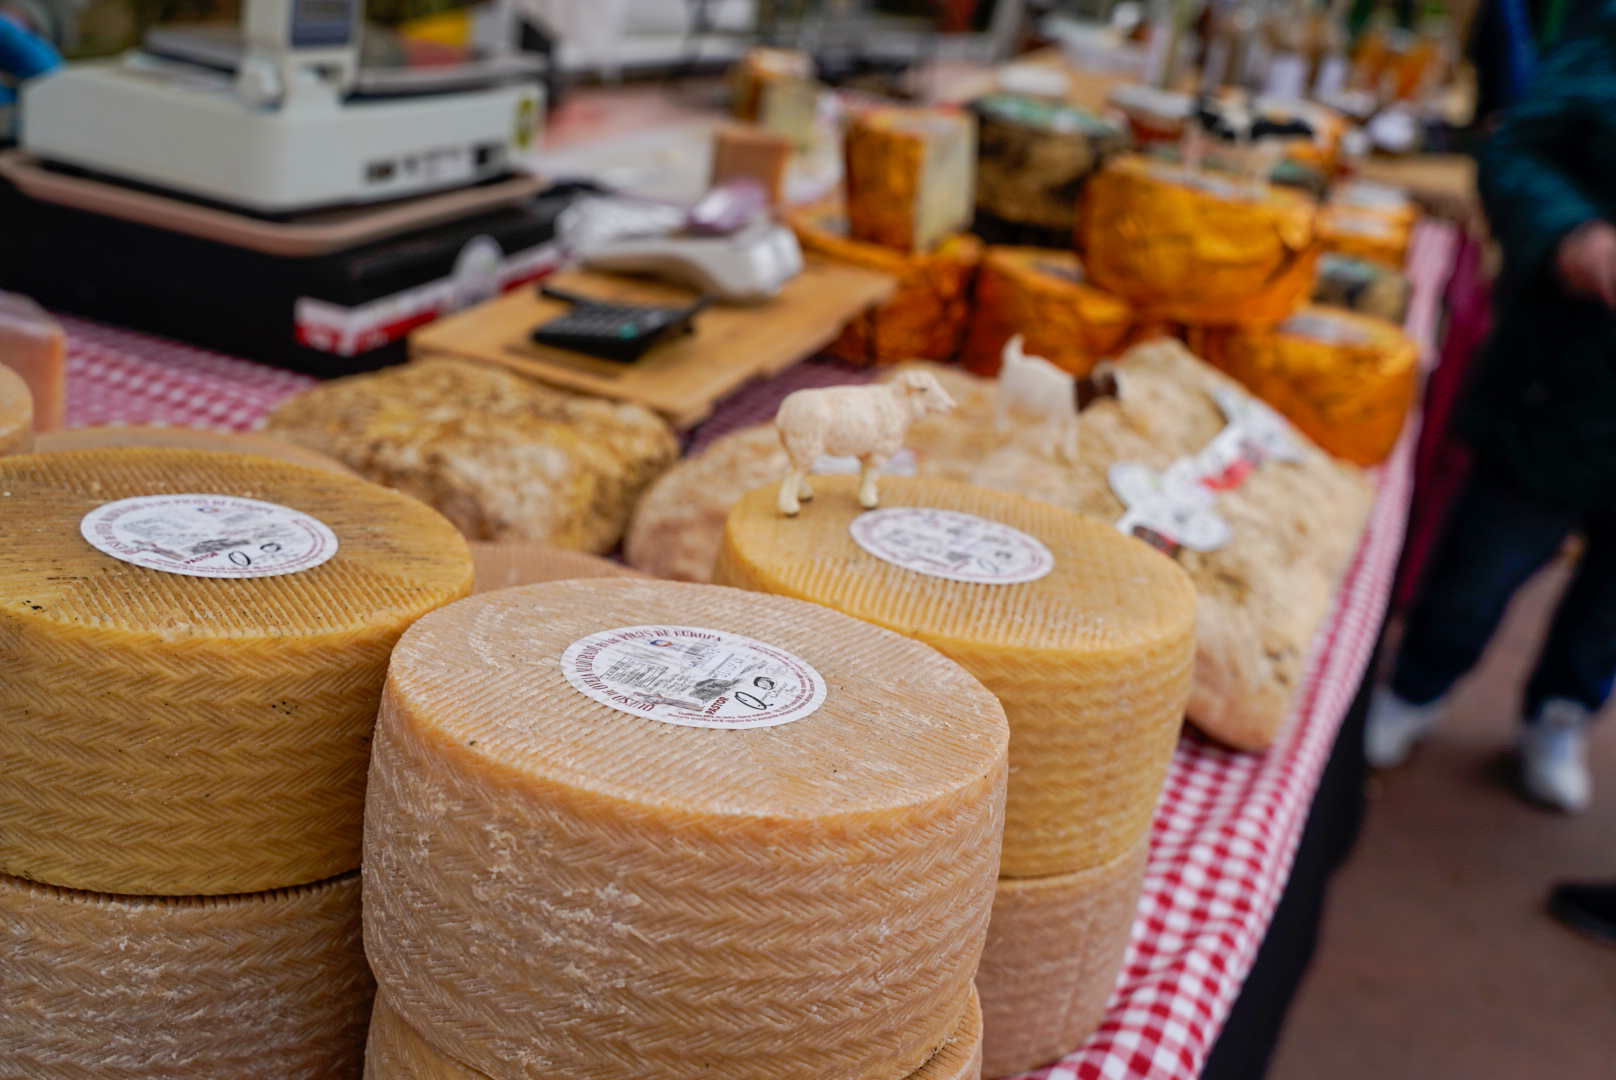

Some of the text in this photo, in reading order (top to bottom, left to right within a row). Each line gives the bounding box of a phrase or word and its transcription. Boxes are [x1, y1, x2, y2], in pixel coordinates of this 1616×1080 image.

[654, 629, 671, 638] DE
[674, 630, 721, 641] EUROPA
[580, 673, 609, 691] OVEJA
[611, 695, 656, 712] QUESO
[705, 696, 729, 715] PASTOR
